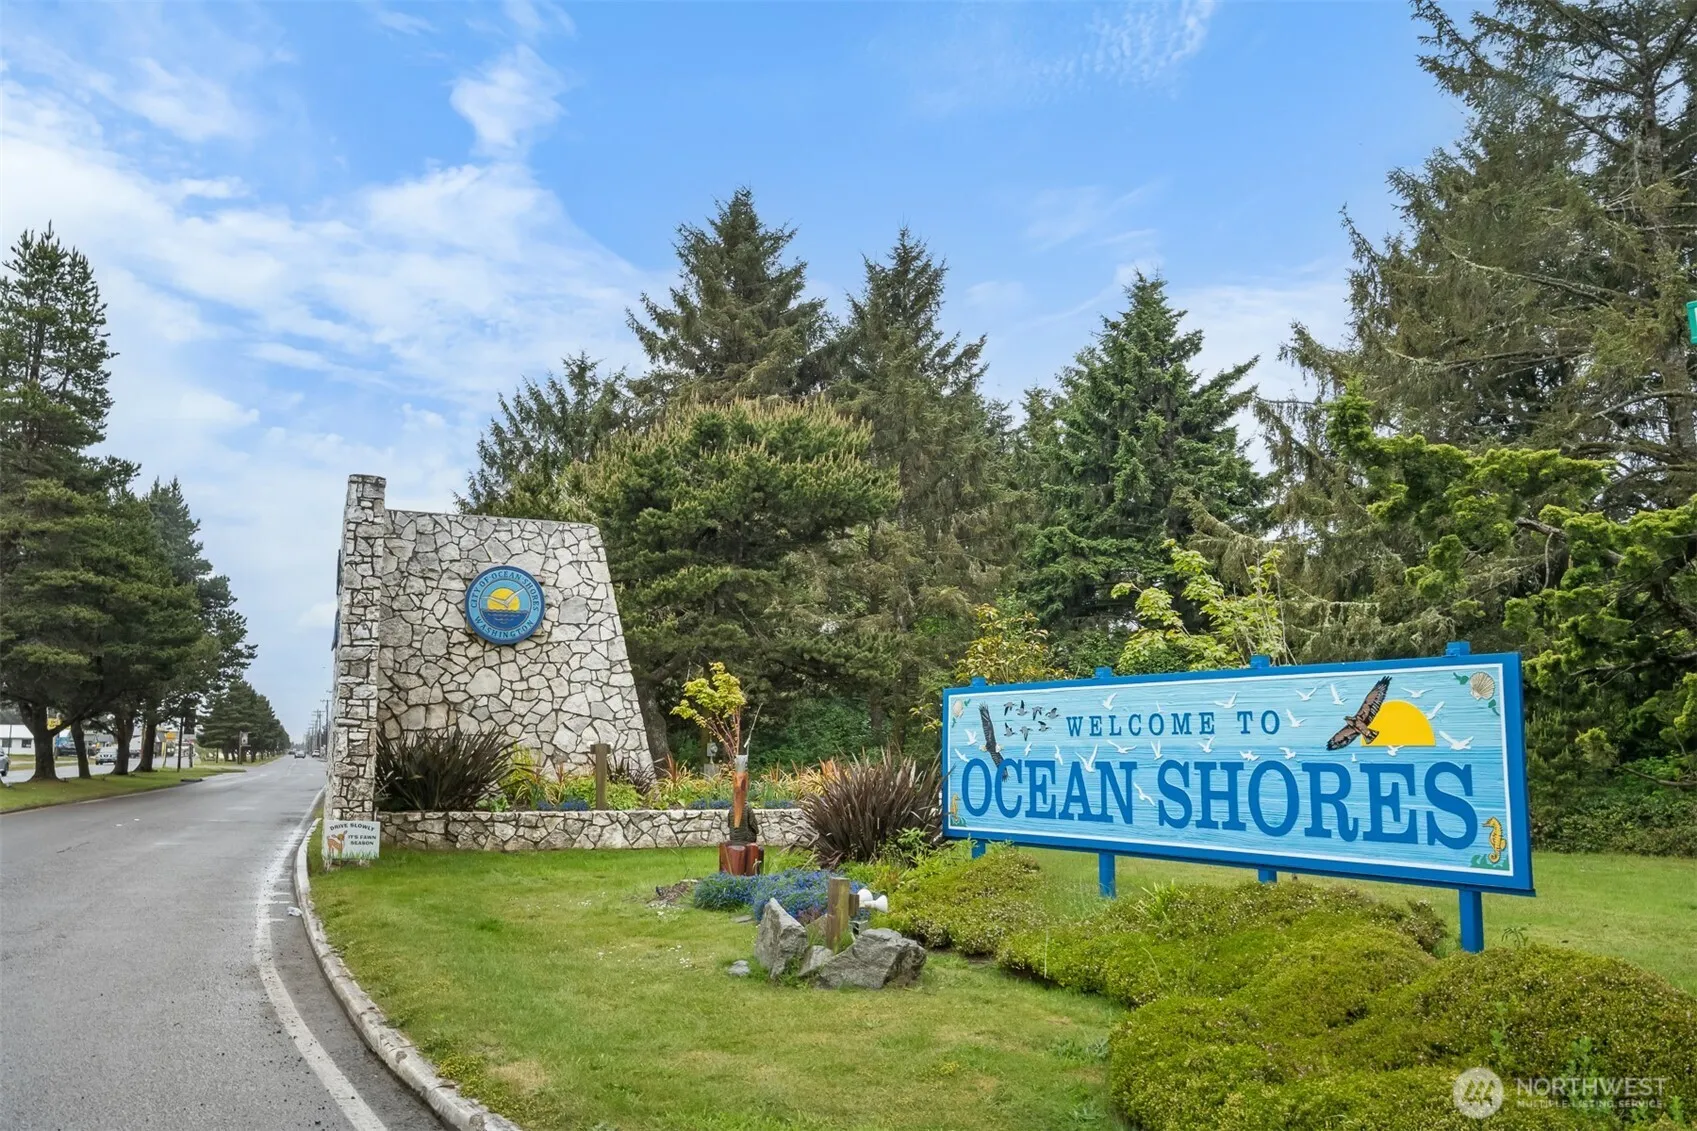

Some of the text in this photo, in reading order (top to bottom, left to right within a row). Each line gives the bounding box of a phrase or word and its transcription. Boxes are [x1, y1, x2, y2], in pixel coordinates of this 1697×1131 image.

[470, 570, 539, 611] CITY OF OCEAN SHORES
[474, 615, 534, 638] WASHINGTON
[1066, 710, 1280, 737] WELCOME TO
[961, 758, 1479, 850] OCEAN SHORES
[330, 823, 375, 832] DRIVE SLOWLY
